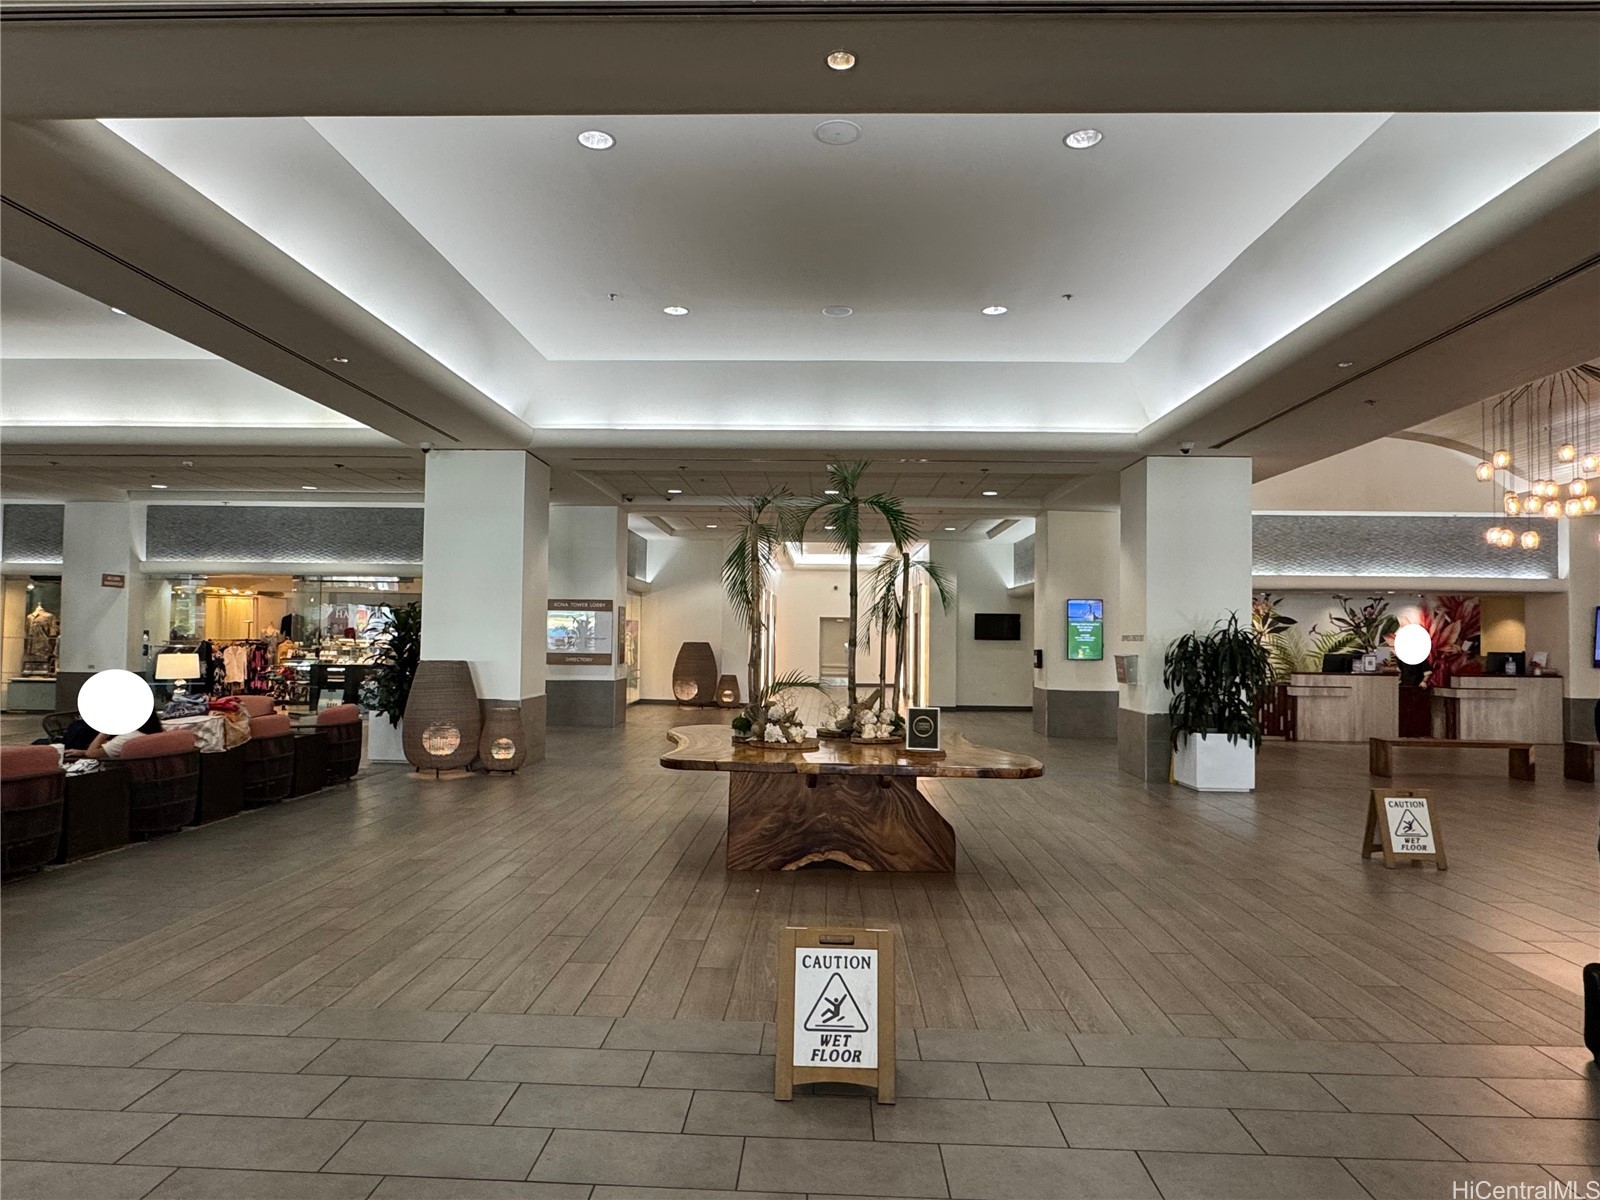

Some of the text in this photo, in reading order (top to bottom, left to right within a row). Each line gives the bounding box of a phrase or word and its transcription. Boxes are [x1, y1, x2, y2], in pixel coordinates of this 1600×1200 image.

[802, 955, 872, 969] CAUTION
[820, 1034, 852, 1047] WET
[810, 1049, 862, 1063] FLOOR
